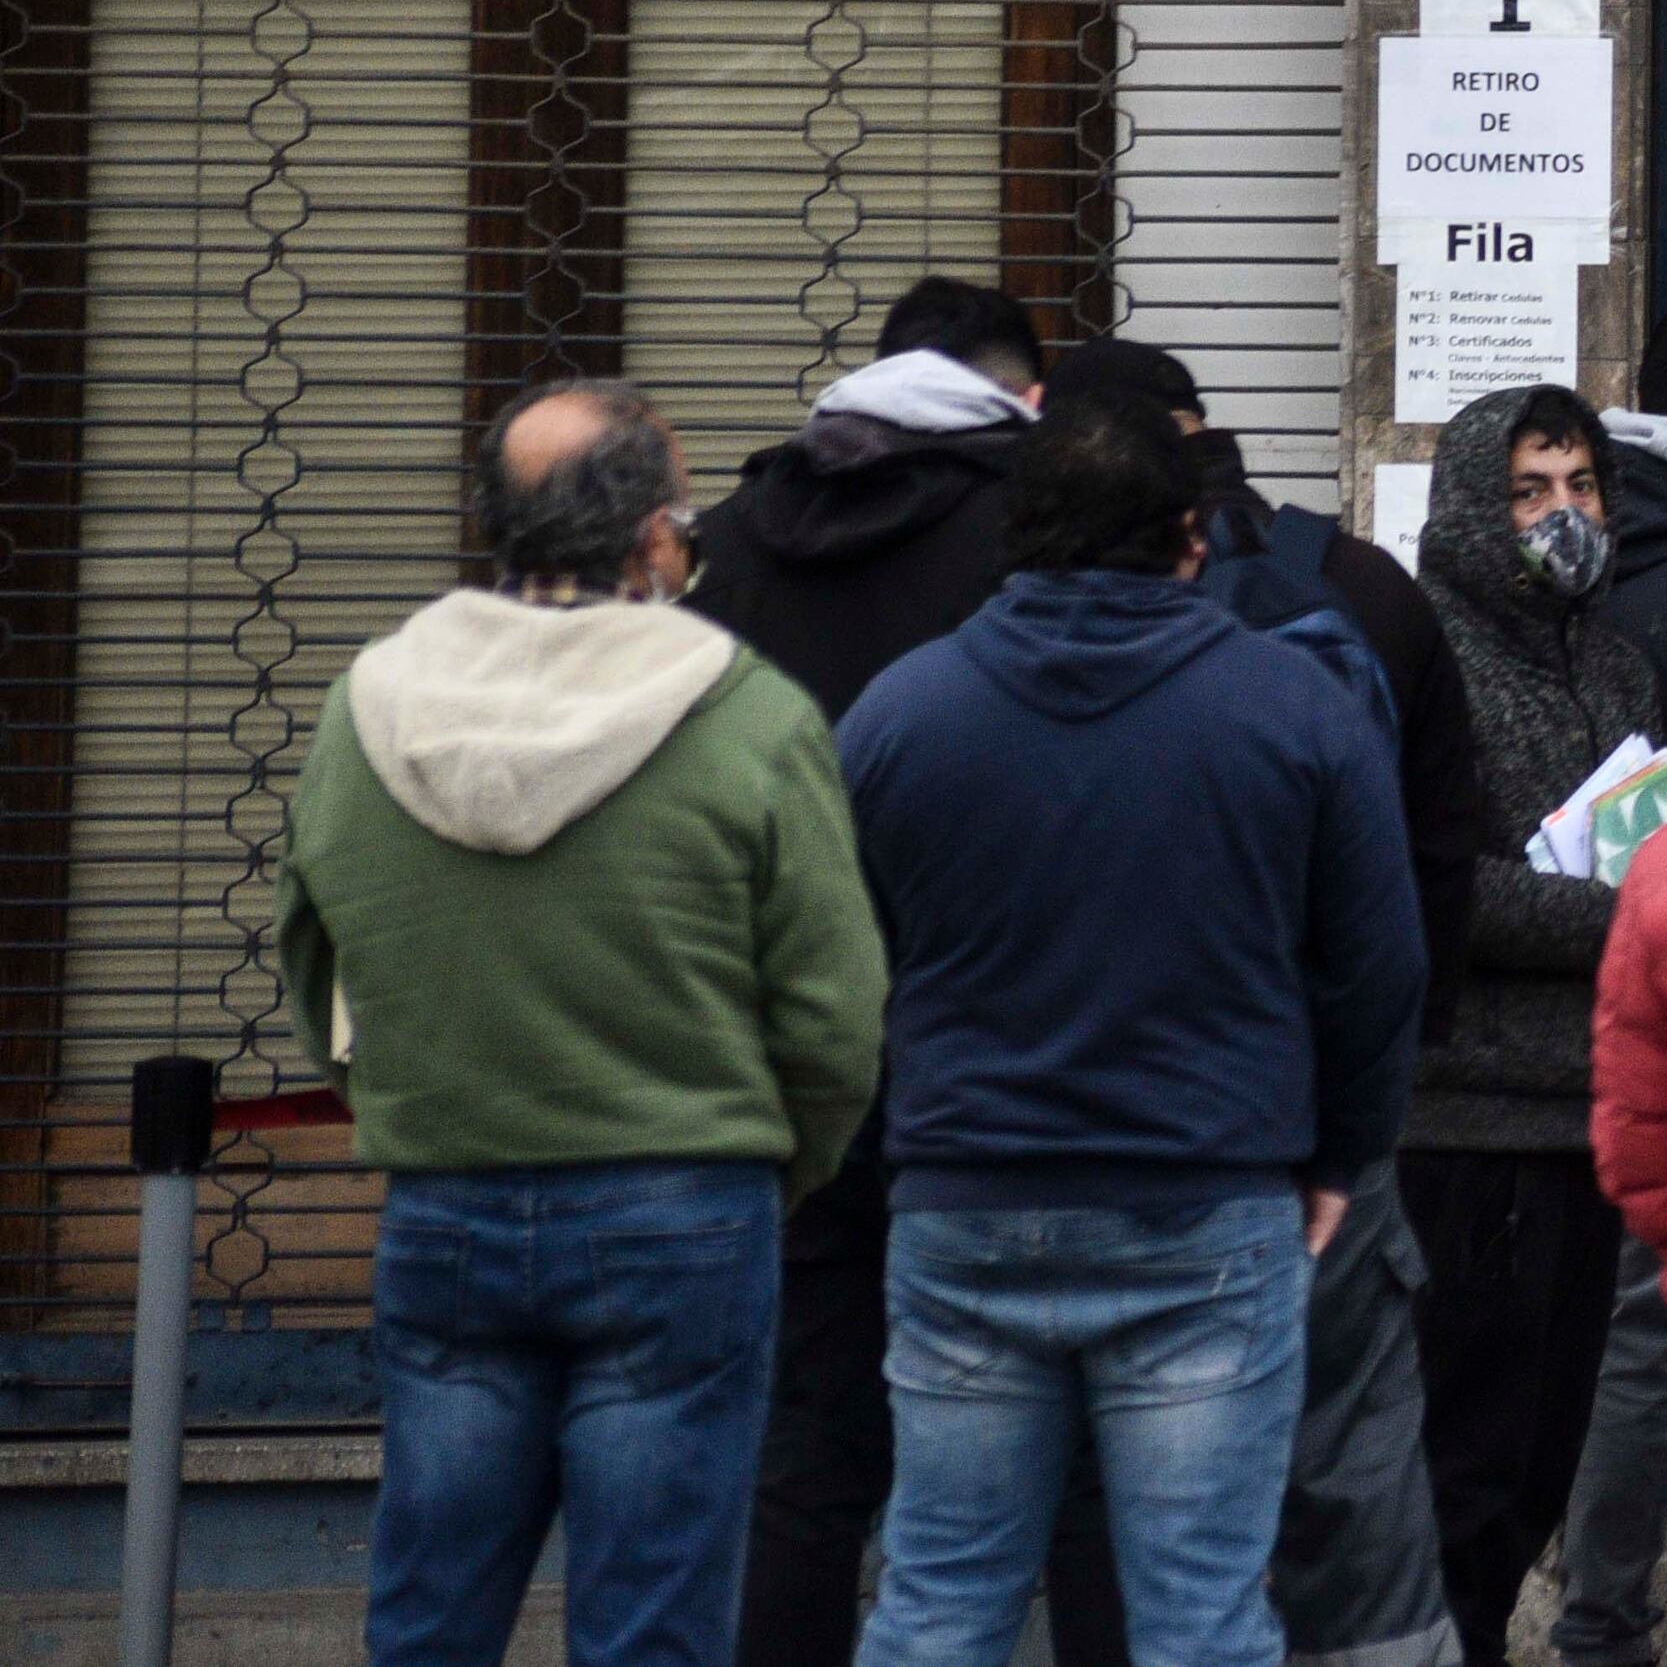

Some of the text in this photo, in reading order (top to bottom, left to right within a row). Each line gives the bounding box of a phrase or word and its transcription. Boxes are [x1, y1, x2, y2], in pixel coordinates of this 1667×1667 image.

[1453, 72, 1539, 91] RETIRO
[1481, 113, 1510, 132] DE
[1407, 153, 1584, 173] DOCUMENTOS
[1448, 223, 1533, 262] Fila
[1450, 290, 1498, 302] Retirar
[1450, 313, 1507, 325] Renovar
[1449, 335, 1533, 348] Certificados
[1449, 369, 1543, 383] Inscripciones
